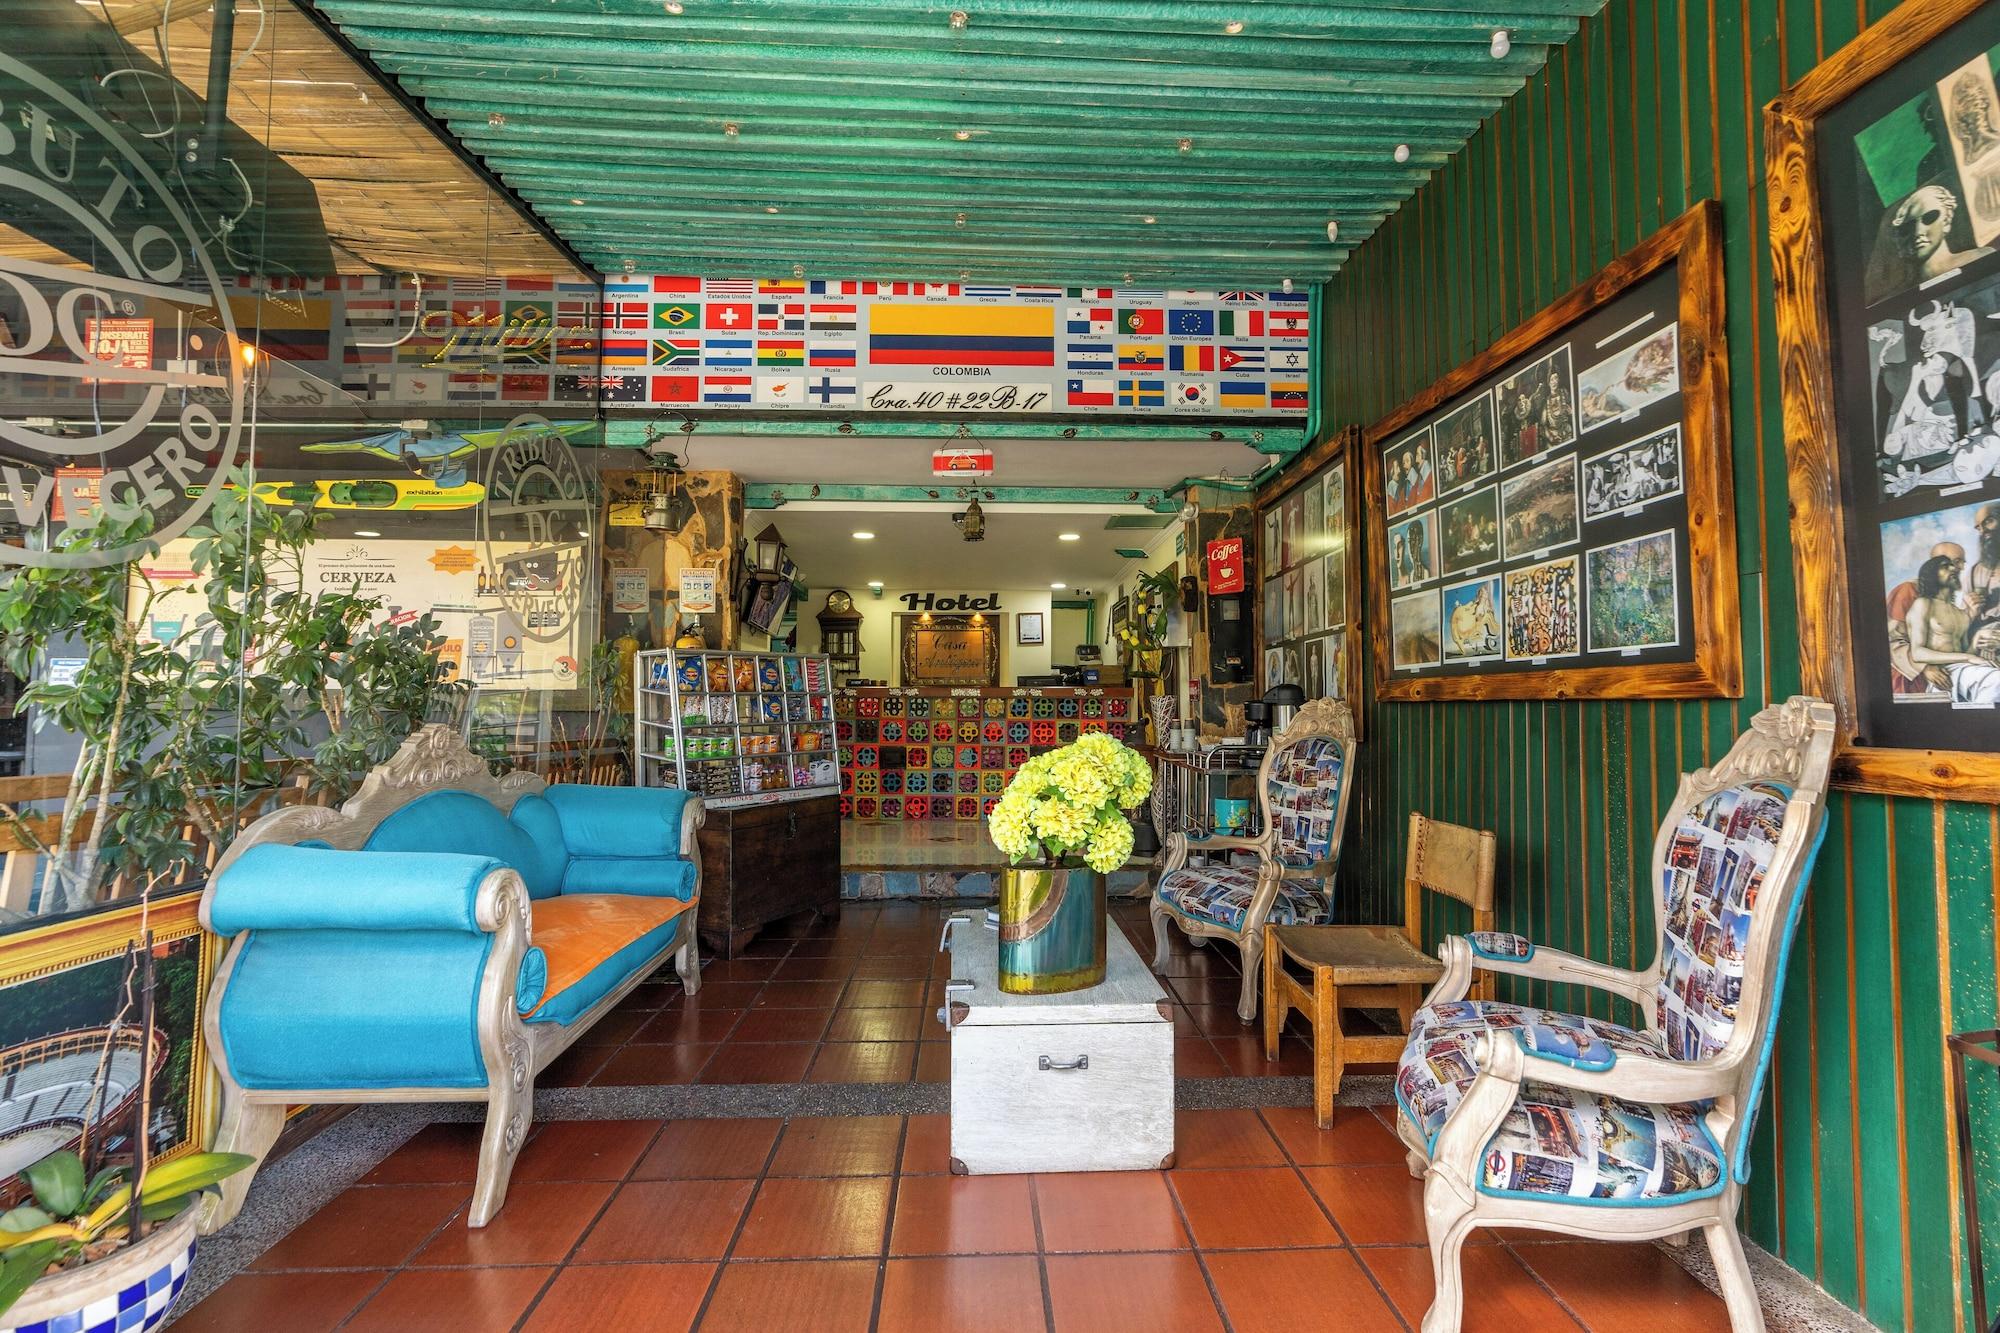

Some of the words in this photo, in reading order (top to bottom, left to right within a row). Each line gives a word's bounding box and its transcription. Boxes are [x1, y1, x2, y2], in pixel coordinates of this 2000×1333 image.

[0, 100, 183, 283] UTO
[932, 367, 991, 376] COLOMBIA
[494, 432, 577, 500] TRIBUTO
[1211, 544, 1239, 561] Coffee
[320, 572, 396, 583] CERVEZA
[899, 592, 1002, 611] Hotel
[561, 661, 569, 673] 3
